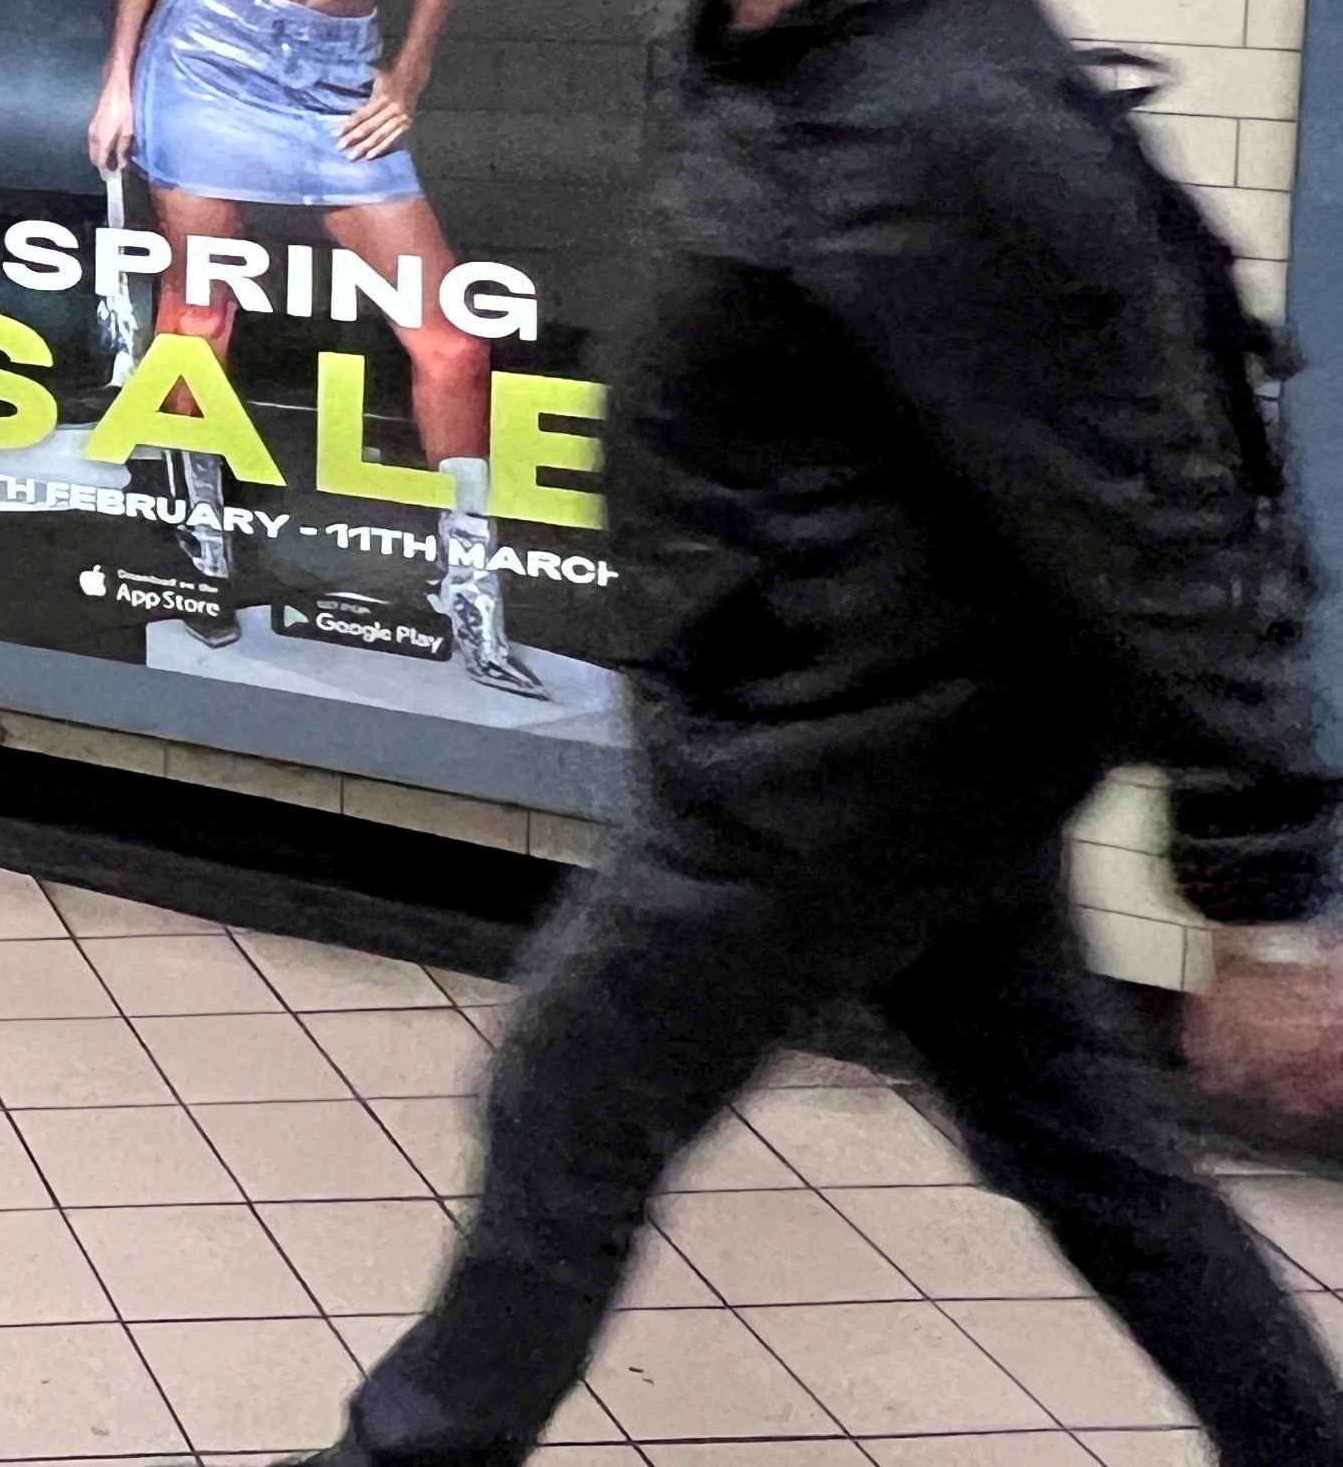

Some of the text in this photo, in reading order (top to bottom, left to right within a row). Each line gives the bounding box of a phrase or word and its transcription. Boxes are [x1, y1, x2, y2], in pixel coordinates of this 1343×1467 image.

[1, 218, 539, 342] SPRING
[45, 483, 291, 539] FEBRUARY
[324, 522, 437, 562] 11TH
[116, 583, 221, 617] App Store
[315, 612, 445, 654] Google Play
